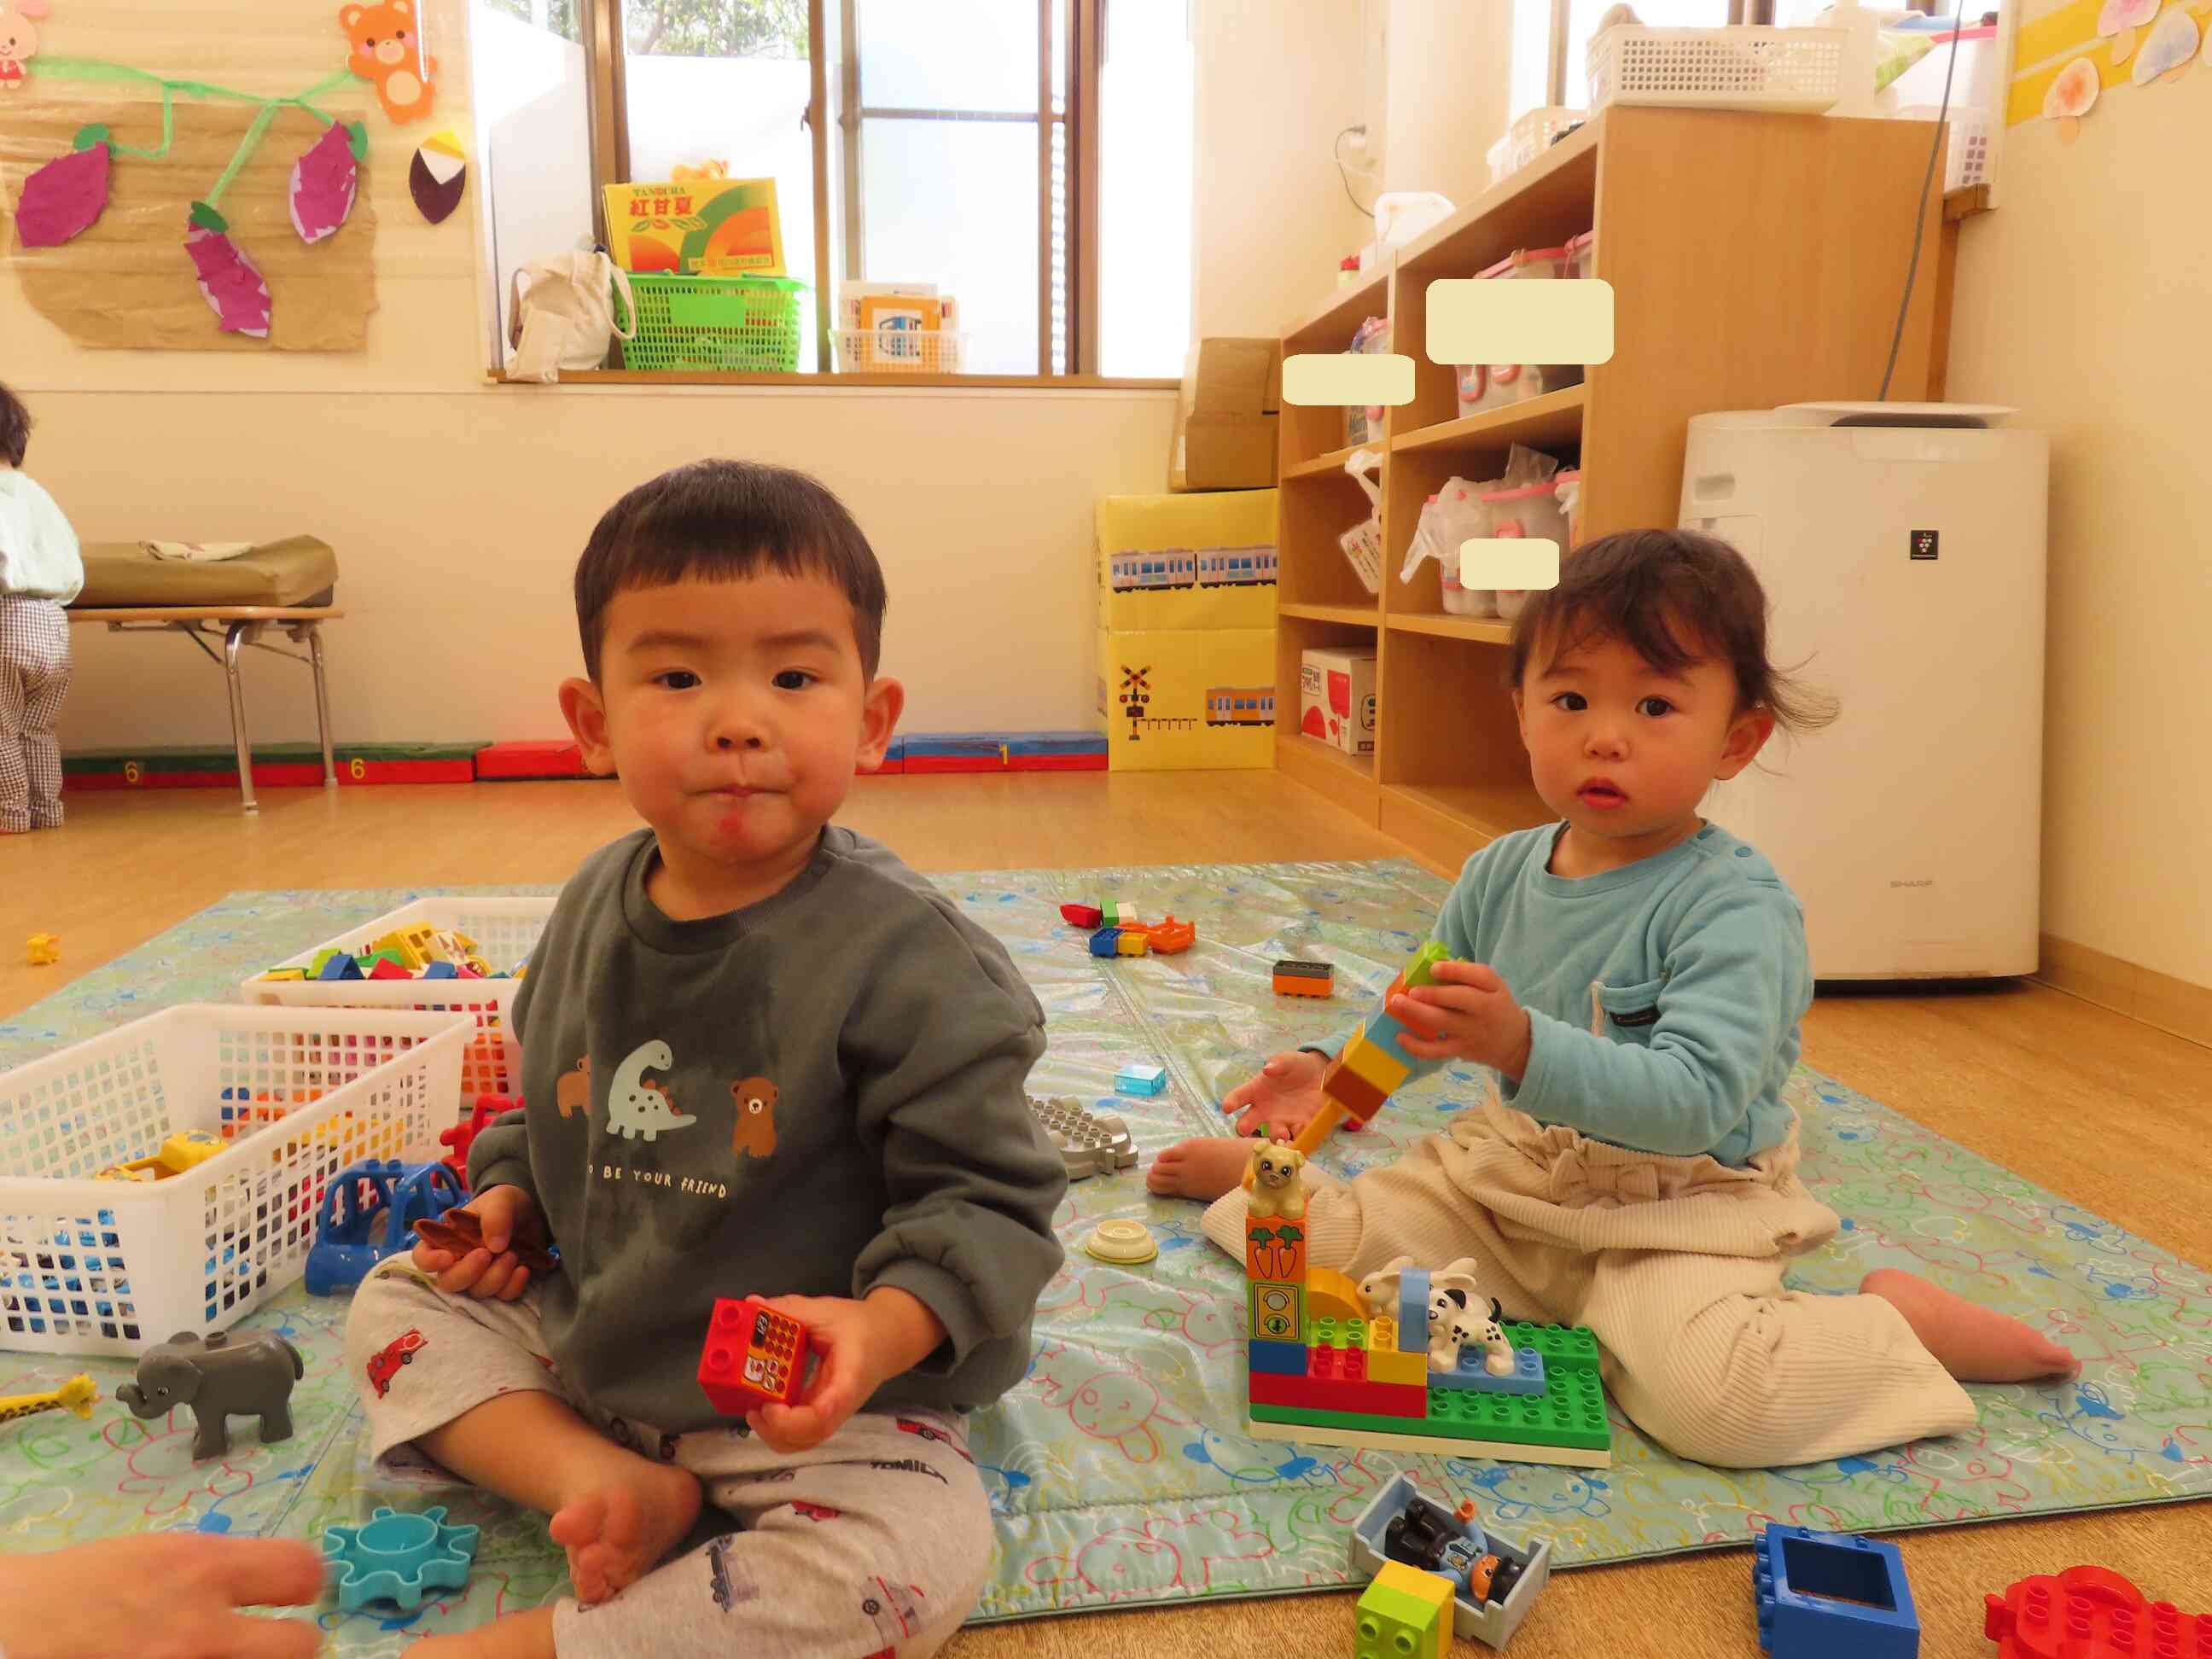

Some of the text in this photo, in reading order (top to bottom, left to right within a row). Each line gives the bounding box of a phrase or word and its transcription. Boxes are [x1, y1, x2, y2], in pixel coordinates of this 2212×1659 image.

[630, 196, 694, 217] 紅甘夏
[125, 760, 138, 783] 6
[351, 758, 365, 778] 6
[603, 1165, 622, 1179] BE
[632, 1169, 672, 1188] YOUR
[680, 1176, 727, 1199] FRIEND
